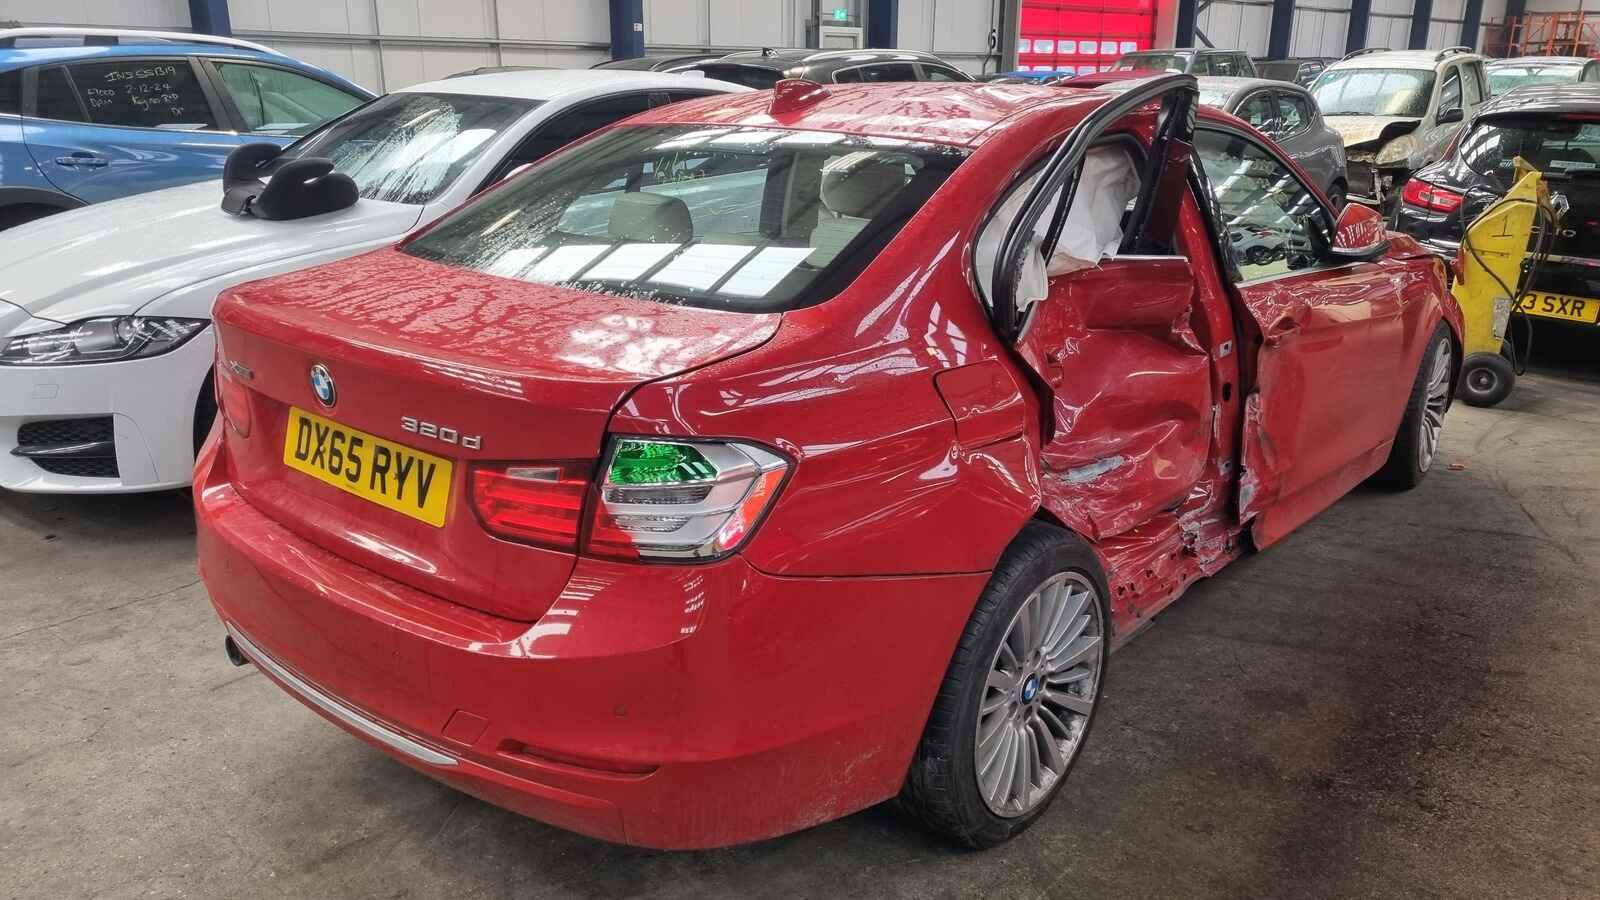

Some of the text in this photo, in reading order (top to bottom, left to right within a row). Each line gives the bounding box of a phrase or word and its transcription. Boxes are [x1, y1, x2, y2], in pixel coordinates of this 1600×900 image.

[1541, 296, 1586, 317] SXR
[294, 415, 437, 510] DX65 RYV
